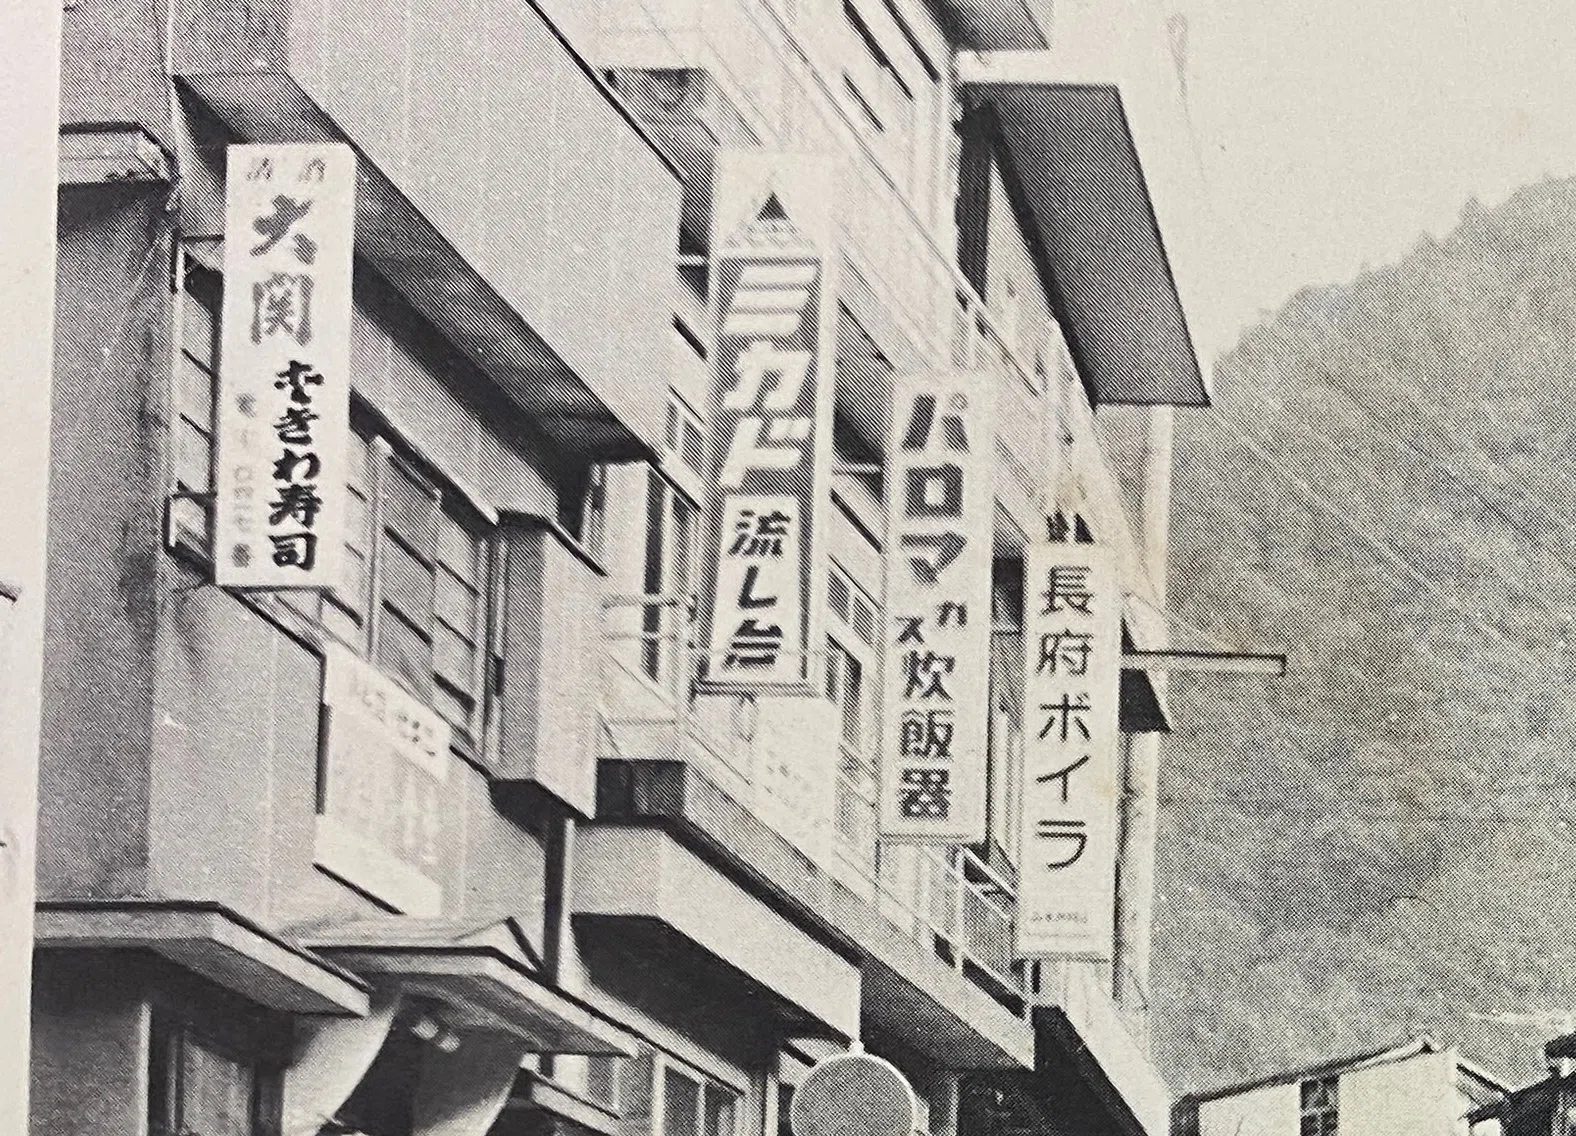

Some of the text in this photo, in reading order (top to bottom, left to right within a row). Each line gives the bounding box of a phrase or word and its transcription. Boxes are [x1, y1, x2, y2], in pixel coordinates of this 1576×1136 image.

[721, 509, 792, 672] 流し台
[1035, 565, 1094, 868] 長府ボイラ
